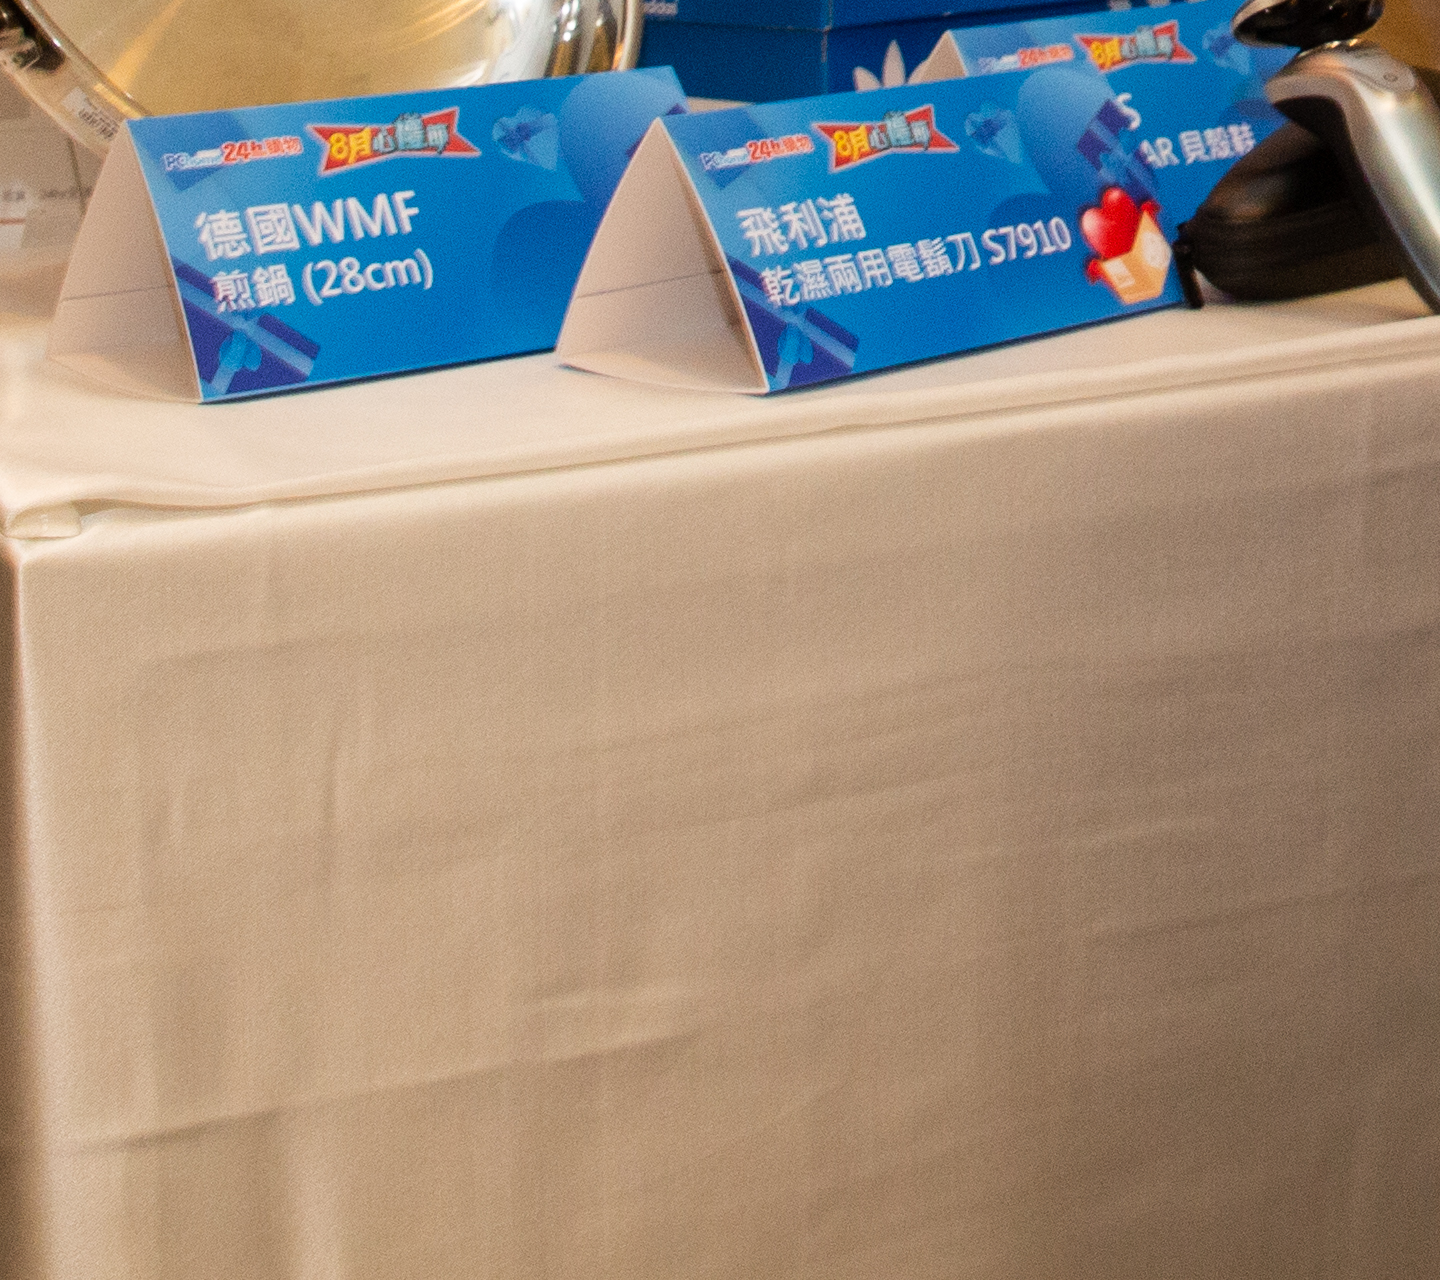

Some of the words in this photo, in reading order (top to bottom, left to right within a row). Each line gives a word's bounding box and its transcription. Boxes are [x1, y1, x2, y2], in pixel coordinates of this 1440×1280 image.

[194, 189, 420, 262] 德國WMF
[735, 192, 867, 258] 飛利浦
[980, 215, 1072, 267] S7910
[211, 263, 297, 313] 煎鍋
[302, 248, 435, 306] (28cm)
